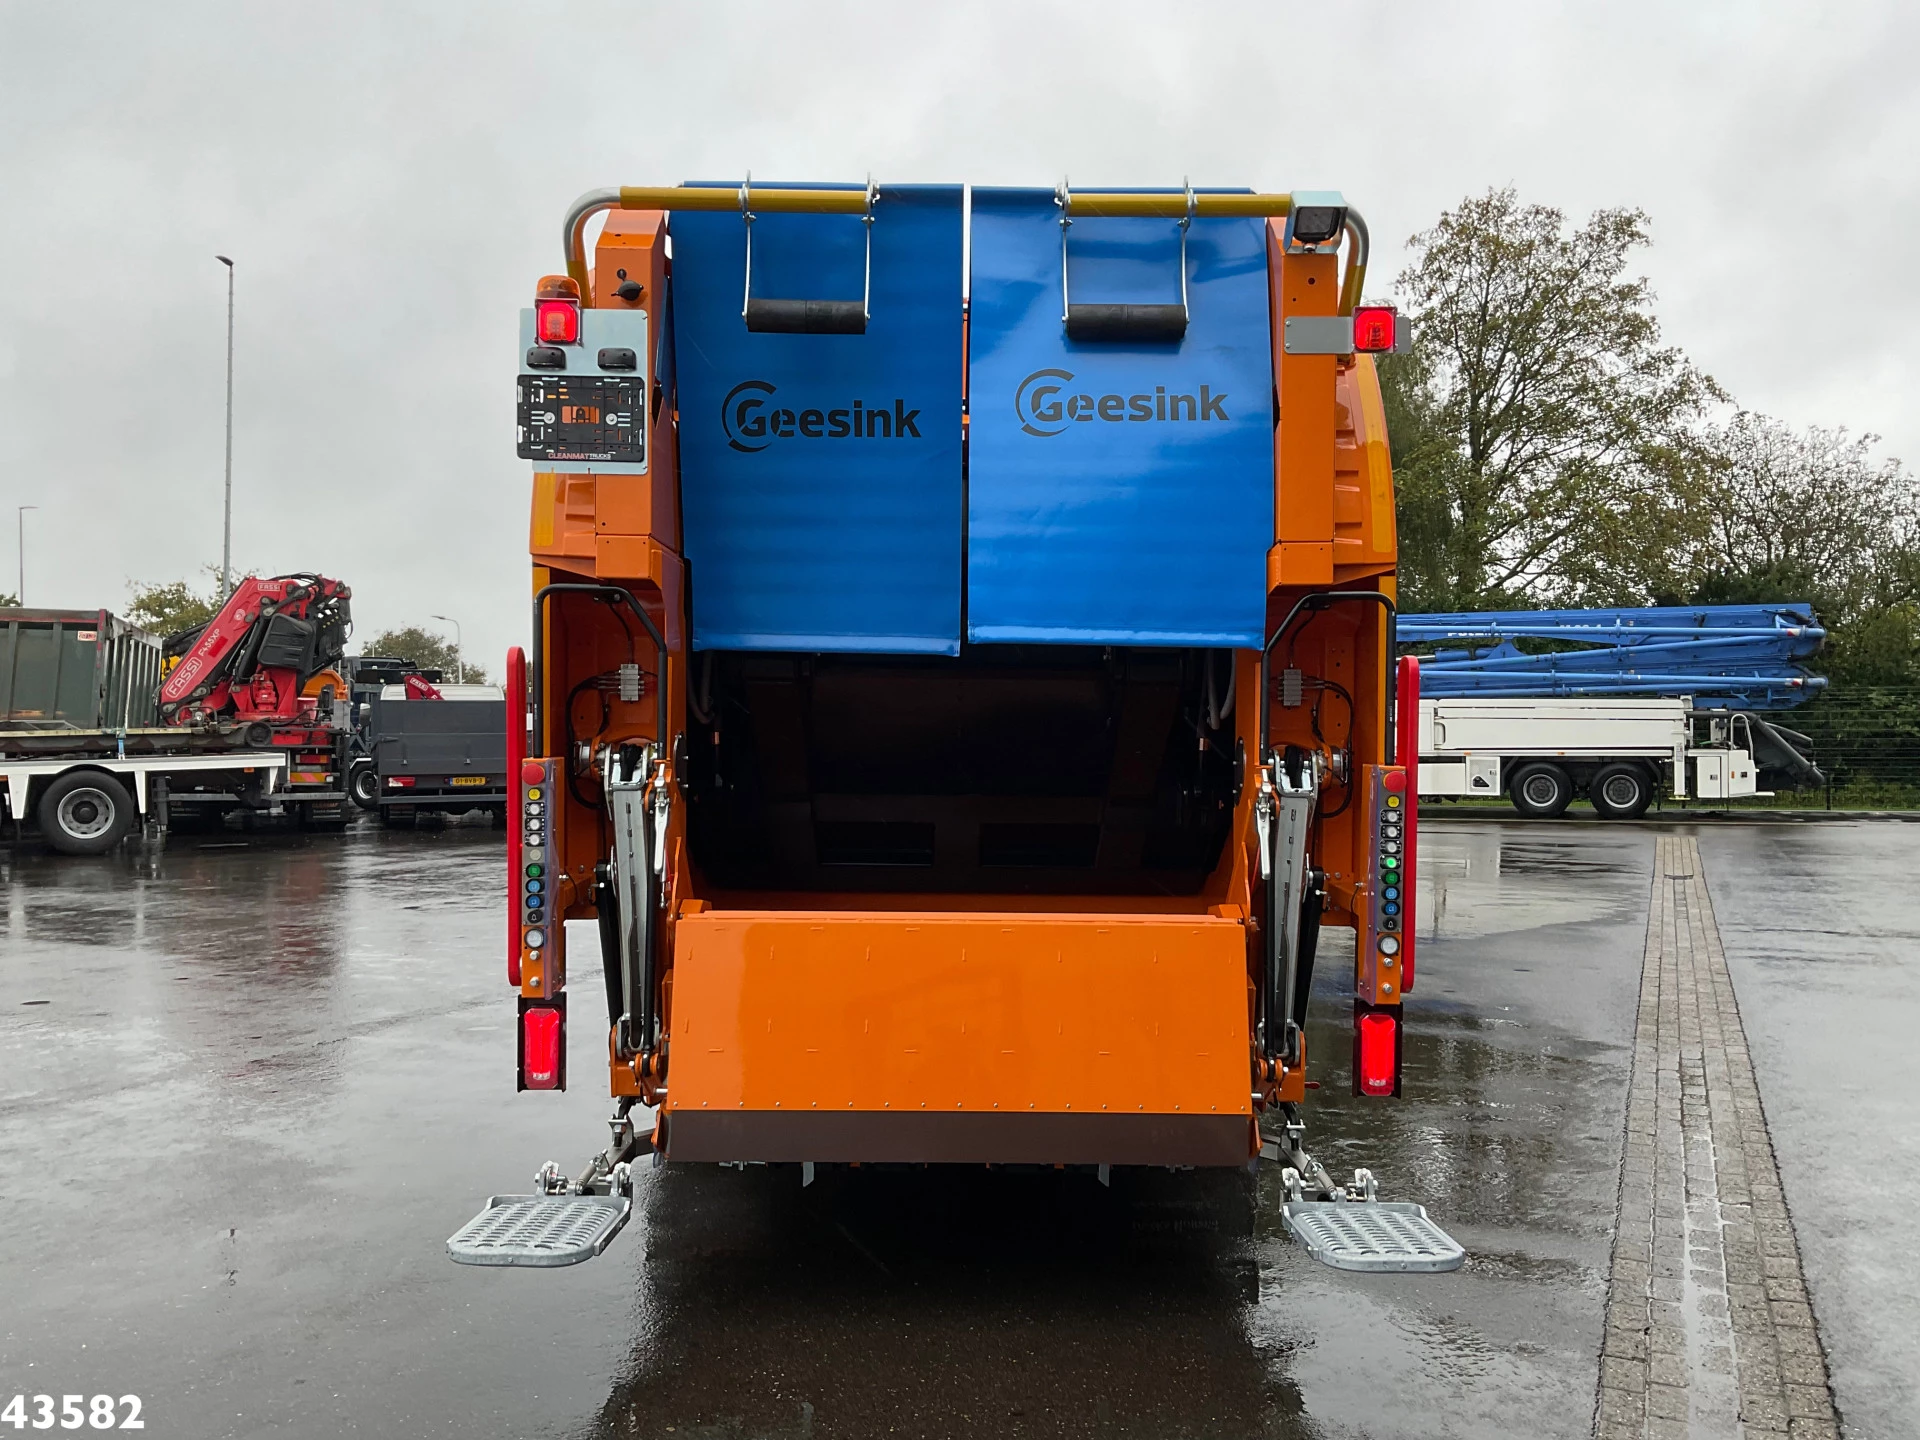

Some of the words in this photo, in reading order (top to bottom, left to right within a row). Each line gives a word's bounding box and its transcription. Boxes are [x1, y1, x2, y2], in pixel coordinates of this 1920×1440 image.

[736, 397, 922, 440] Geesink
[1030, 383, 1230, 422] Geesink
[548, 452, 589, 460] CLEANMAT
[169, 659, 201, 695] FASSI
